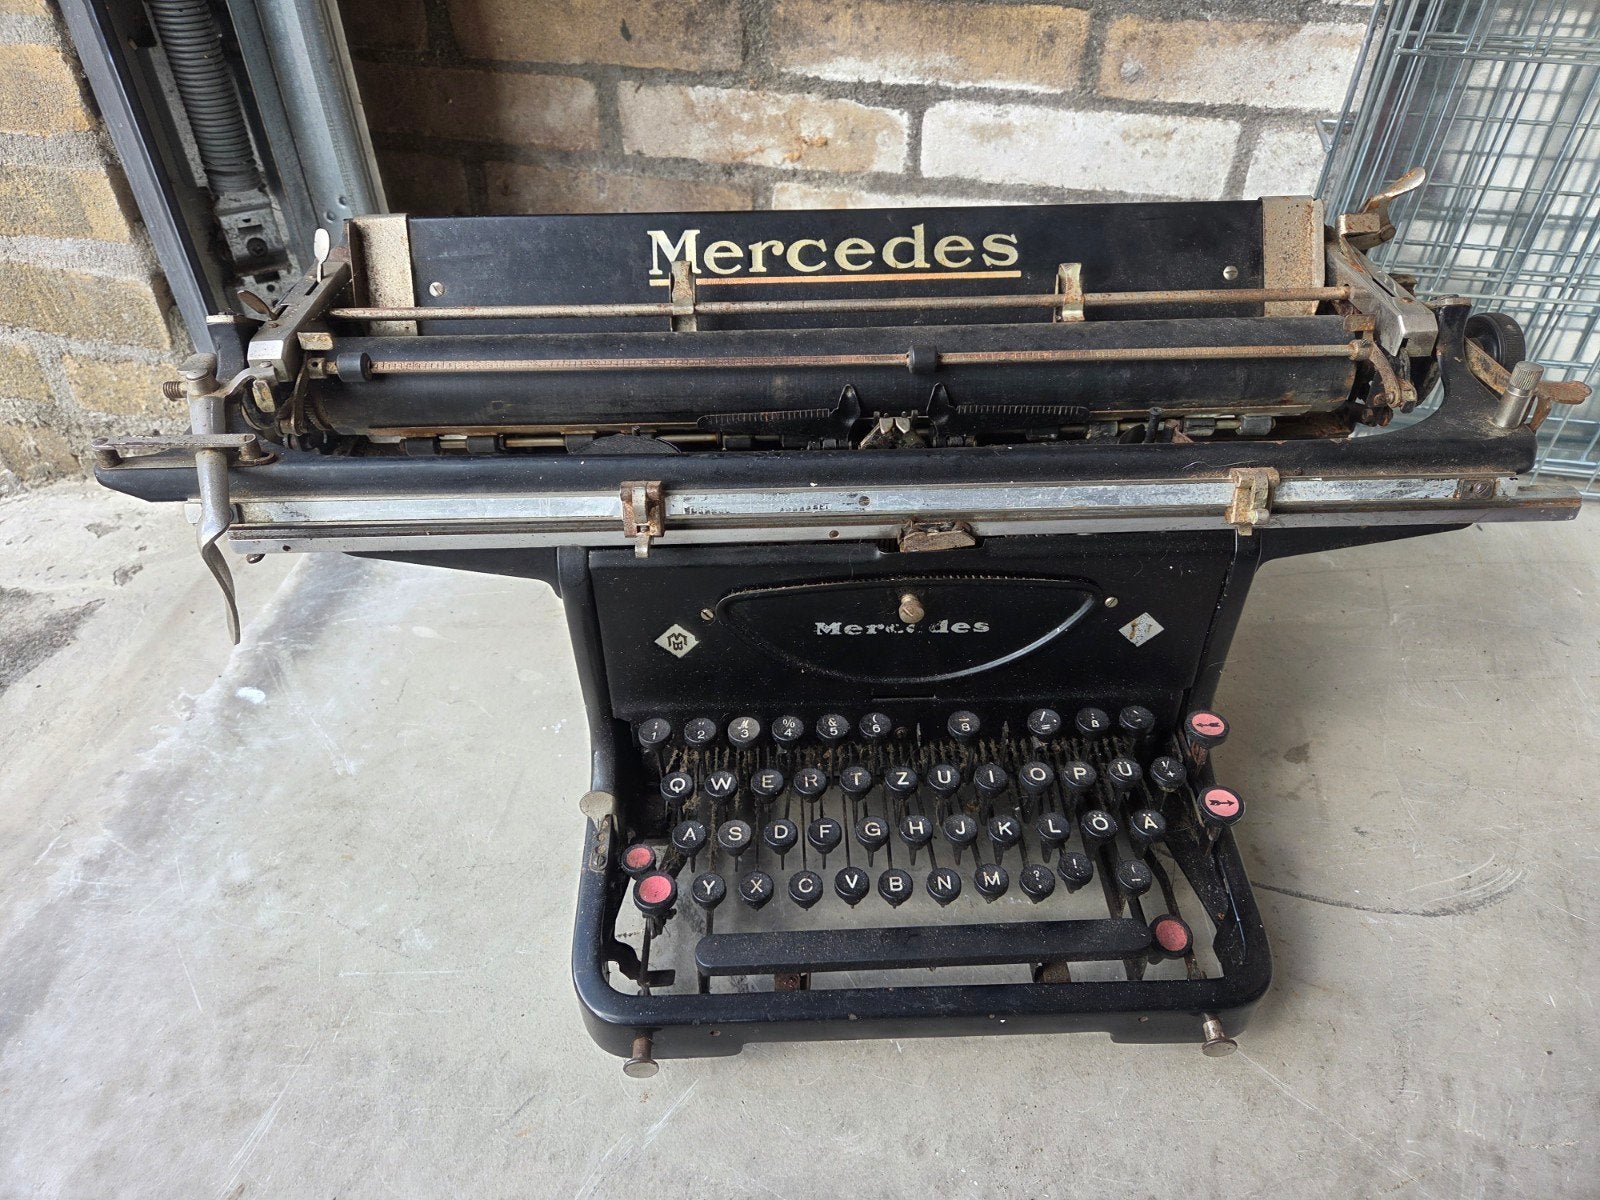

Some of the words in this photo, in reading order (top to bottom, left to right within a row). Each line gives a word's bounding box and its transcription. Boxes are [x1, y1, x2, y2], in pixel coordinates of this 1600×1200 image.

[647, 224, 1019, 275] Mercedes
[988, 770, 995, 783] I
[1029, 767, 1047, 781] O
[1073, 767, 1087, 780] P
[1117, 761, 1133, 777] Ü
[710, 776, 732, 791] W
[761, 774, 775, 788] E
[804, 773, 819, 788] R
[852, 772, 863, 786] T
[896, 771, 910, 786] Z
[937, 770, 952, 784] U
[669, 777, 686, 793] Q
[864, 821, 882, 837] G
[908, 820, 925, 835] H
[955, 820, 966, 835] J
[998, 821, 1013, 836] K
[1048, 818, 1062, 834] L
[1091, 813, 1109, 832] Ö
[1142, 813, 1159, 831] Ä
[682, 826, 697, 841] A
[728, 826, 743, 841] S
[774, 824, 789, 839] D
[819, 824, 833, 839] F
[750, 878, 763, 894] X
[798, 877, 814, 893] C
[844, 874, 859, 889] V
[889, 876, 904, 892] B
[937, 875, 952, 890] N
[983, 870, 1001, 887] M
[702, 879, 716, 895] Y
